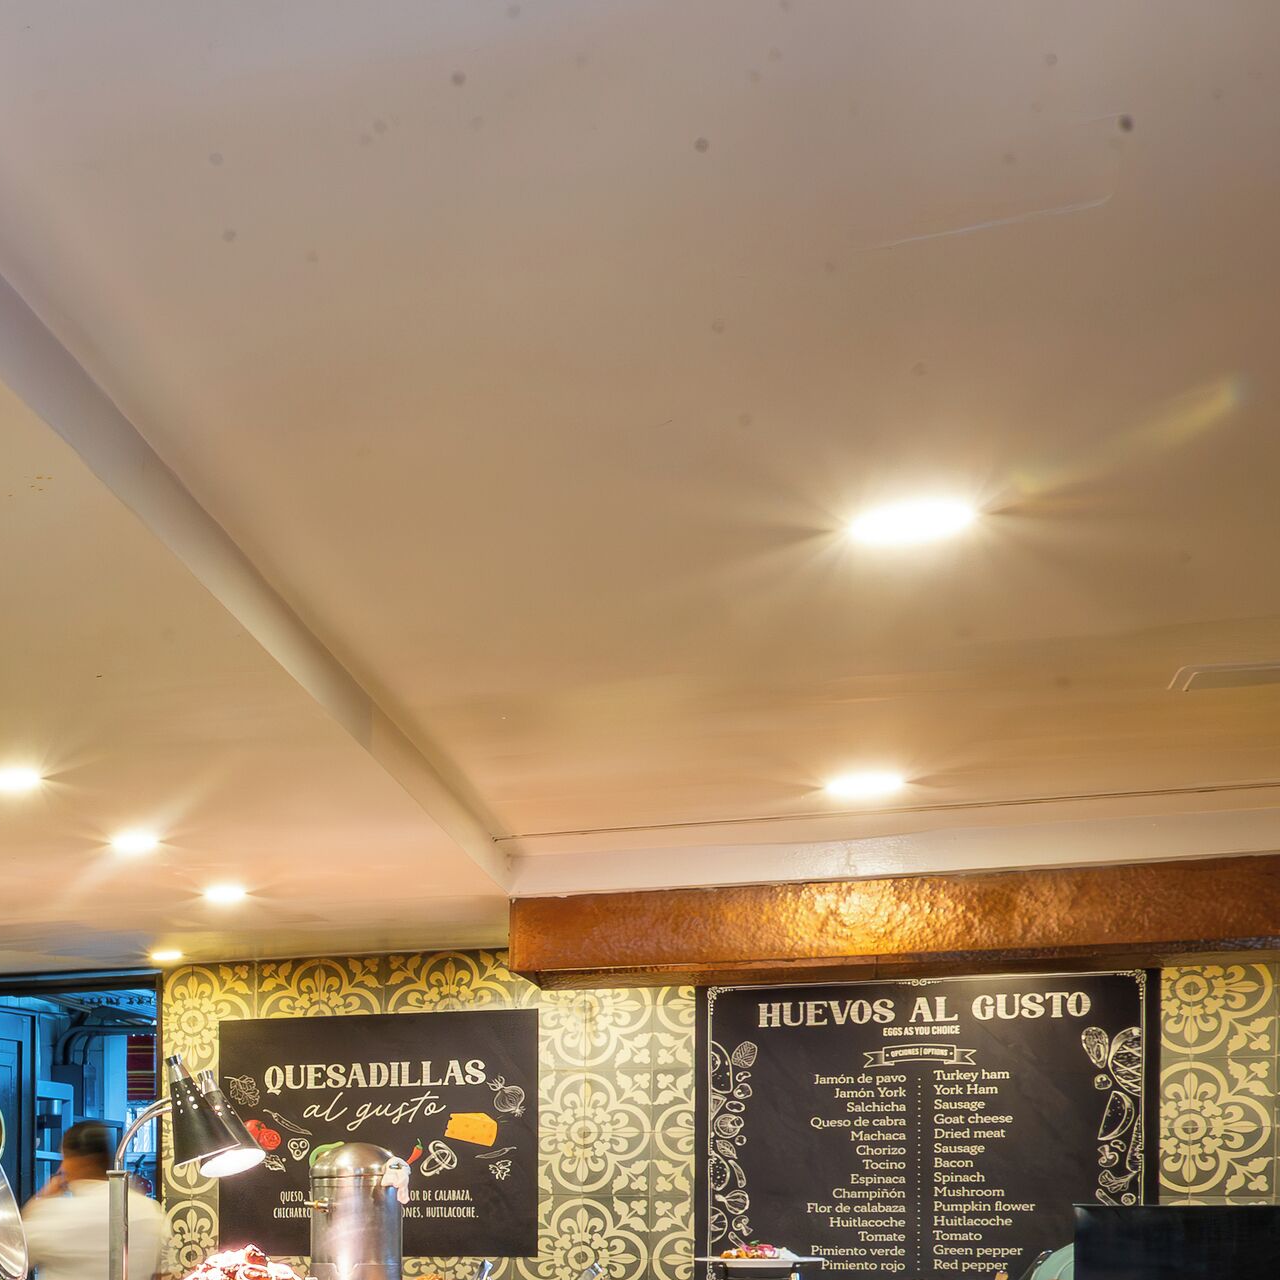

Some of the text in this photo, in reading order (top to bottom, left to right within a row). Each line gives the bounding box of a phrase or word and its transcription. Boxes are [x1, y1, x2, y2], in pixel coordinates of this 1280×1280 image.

[758, 991, 1091, 1028] HUEVOS AL GUSTO
[883, 1025, 960, 1036] EGGS AS YOU CHOICE
[264, 1059, 486, 1096] QUESADILLAS
[814, 1074, 906, 1085] Jamón de pavo
[933, 1069, 1010, 1082] Turkey ham
[834, 1087, 906, 1098] Jamón York
[933, 1084, 998, 1095] York Ham
[847, 1102, 906, 1112] Salchicha
[934, 1099, 985, 1111] Sausage
[303, 1091, 446, 1131] al gusto
[810, 1116, 906, 1129] Queso de cabra
[934, 1113, 1013, 1124] Goat cheese
[850, 1131, 906, 1141] Machaca
[934, 1128, 1005, 1138] Dried meat
[856, 1145, 906, 1155] Chorizo
[934, 1143, 985, 1155] Sausage
[862, 1160, 906, 1169] Tocino
[934, 1158, 973, 1167] Bacon
[850, 1174, 906, 1186] Espinaca
[934, 1172, 985, 1184] Spinach
[410, 1190, 420, 1201] OR
[423, 1190, 431, 1201] DE
[833, 1188, 905, 1200] Champiñón
[934, 1187, 1005, 1196] Mushroom
[807, 1203, 906, 1213] Flor de calabaza
[934, 1201, 1035, 1213] Pumpkin flower
[273, 1208, 311, 1218] CHICHARRO
[829, 1217, 905, 1227] Huitlacoche
[934, 1216, 1012, 1226] Huitlacoche
[858, 1231, 905, 1241] Tomate
[933, 1230, 982, 1240] Tomato
[811, 1245, 905, 1256] Pimiento verde
[933, 1245, 1023, 1257] Green pepper
[822, 1260, 905, 1272] Pimiento rojo
[933, 1259, 1008, 1272] Red pepper
